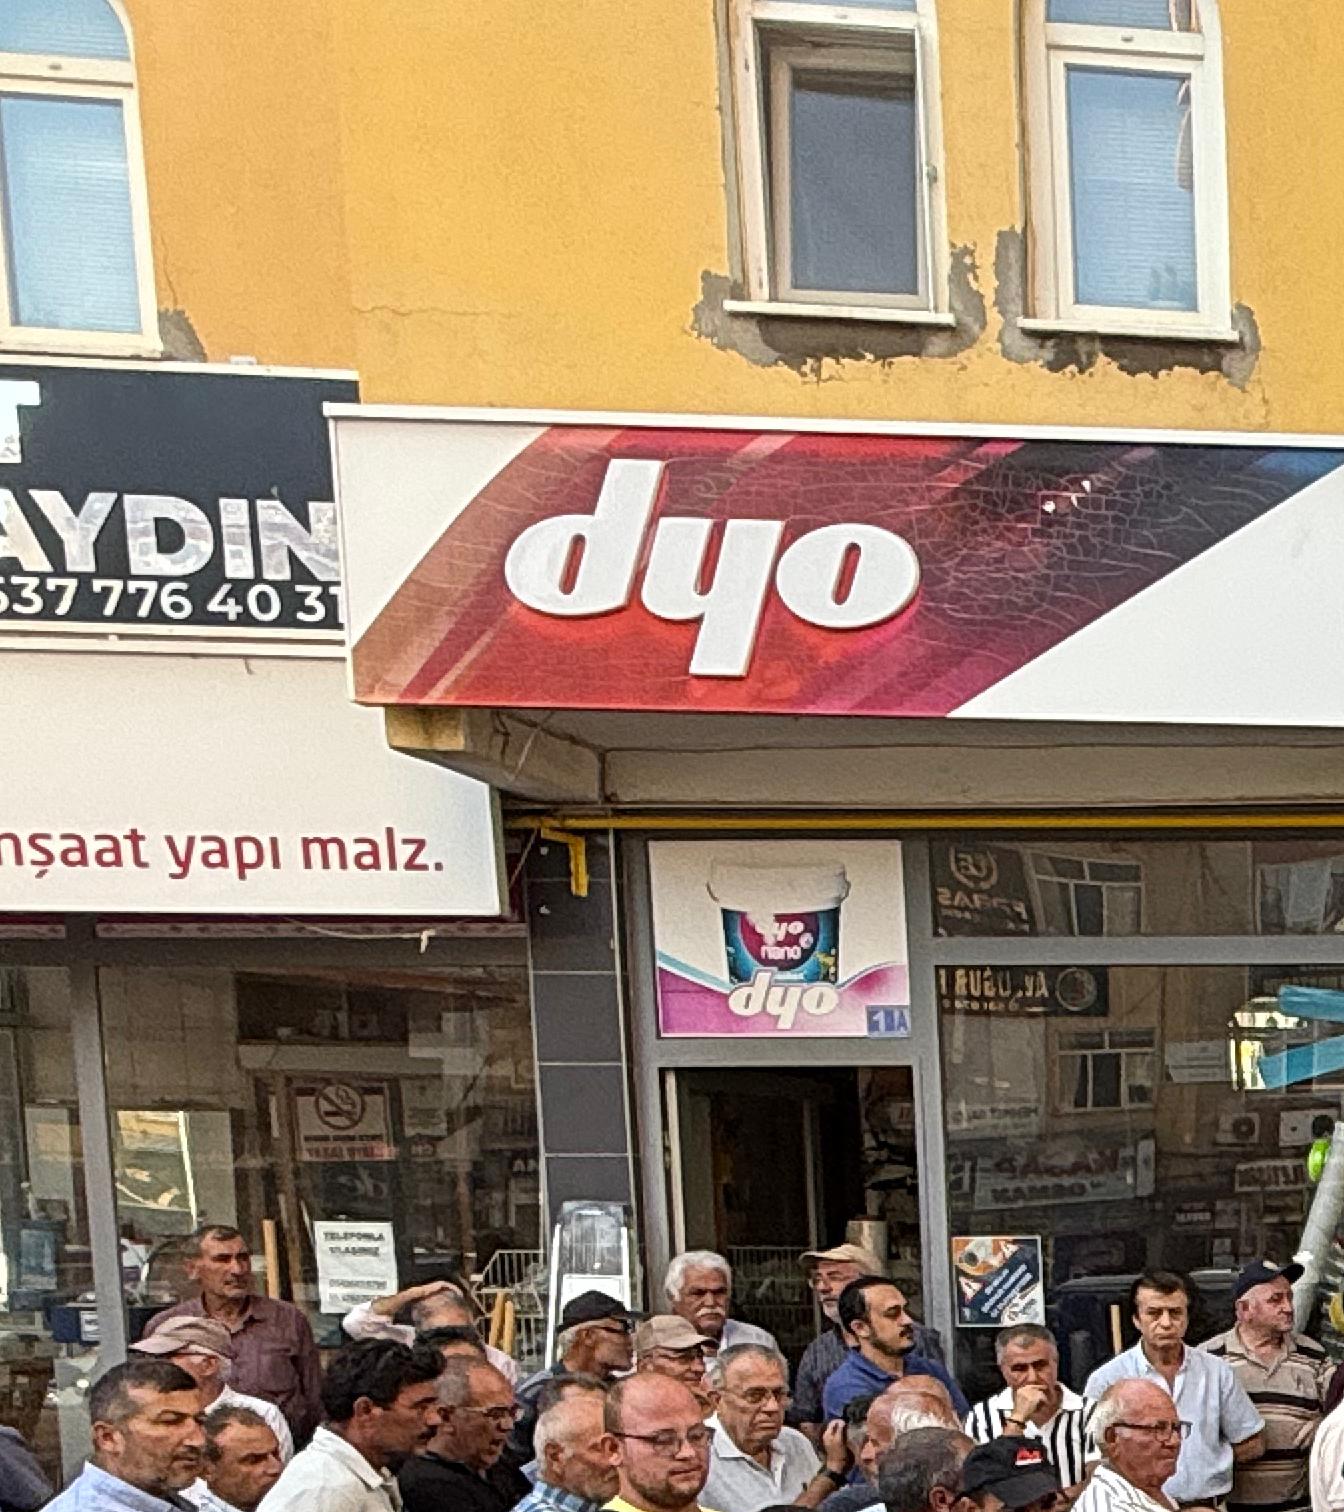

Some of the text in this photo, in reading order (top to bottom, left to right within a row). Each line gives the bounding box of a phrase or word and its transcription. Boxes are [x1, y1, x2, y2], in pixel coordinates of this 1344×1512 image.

[504, 459, 920, 677] dyo
[91, 579, 193, 621] 776
[207, 583, 281, 622] 40
[164, 832, 282, 880] yapı
[302, 826, 444, 872] malz.
[728, 969, 839, 1030] dyo
